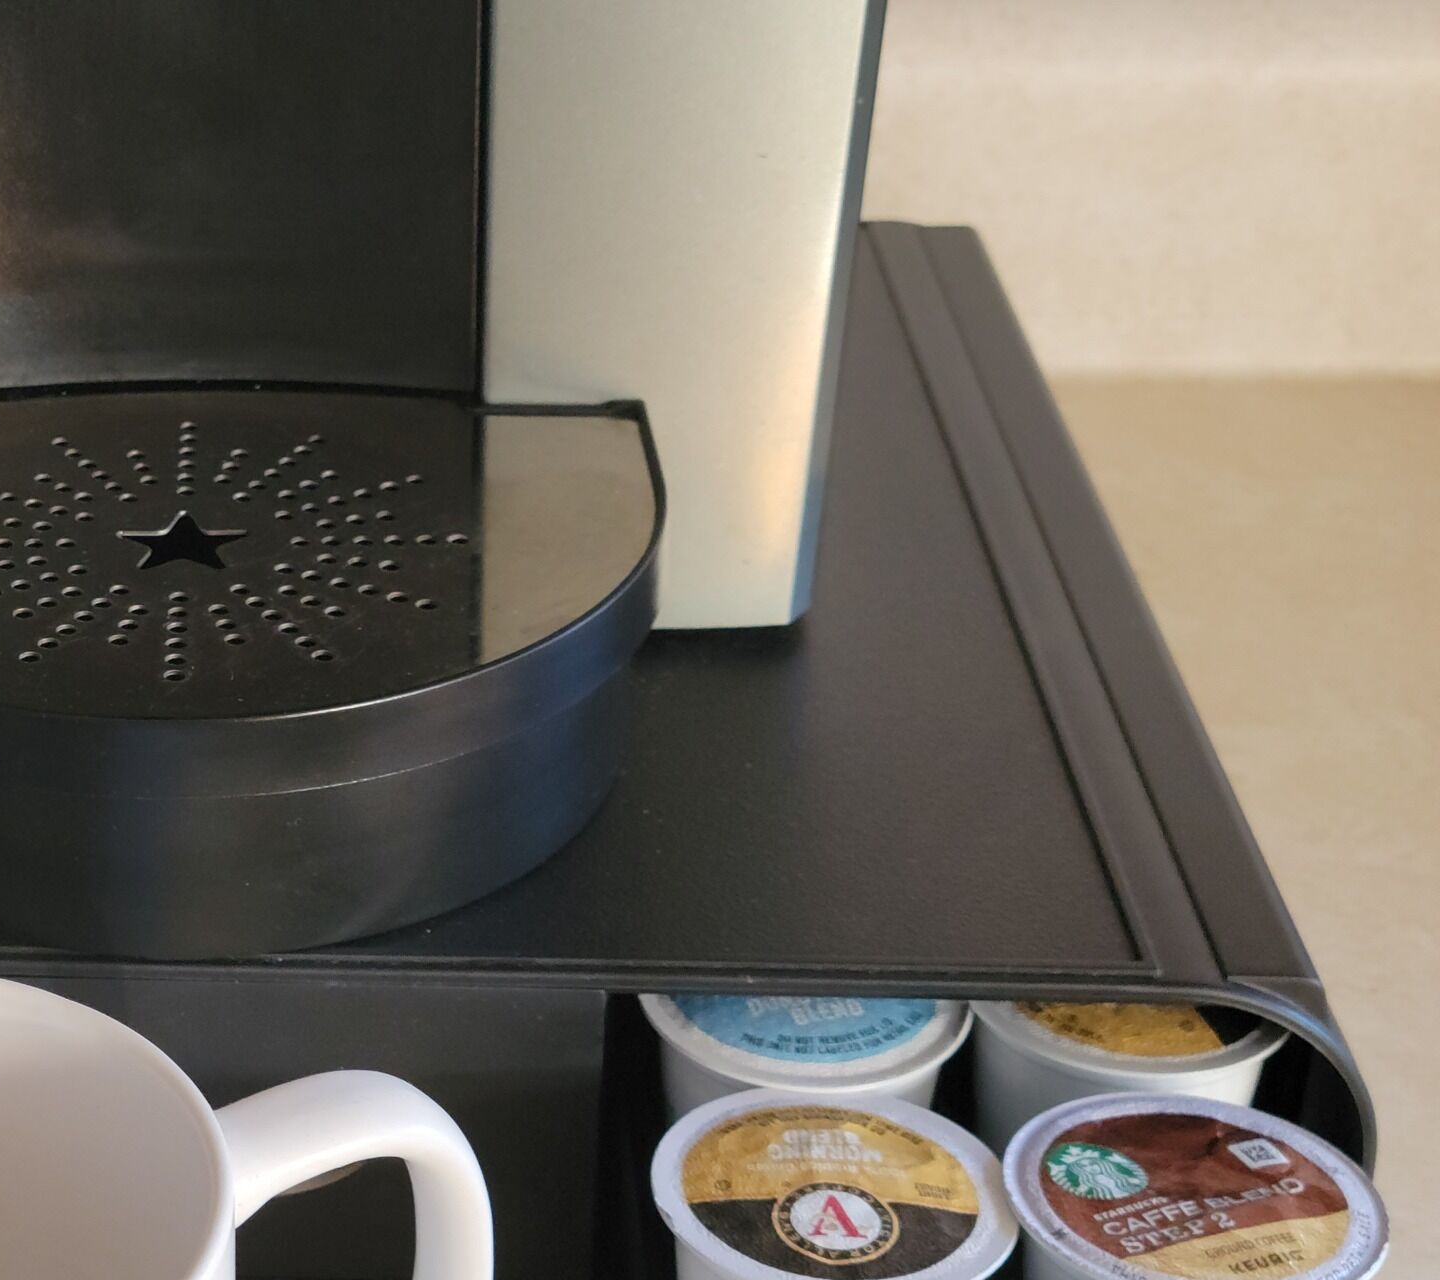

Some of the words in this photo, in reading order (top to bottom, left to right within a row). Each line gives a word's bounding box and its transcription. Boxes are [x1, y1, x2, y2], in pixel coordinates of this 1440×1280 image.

[1204, 1177, 1305, 1209] BLEND
[1120, 1219, 1205, 1254] STEP
[1210, 1211, 1236, 1229] 2
[1228, 1250, 1305, 1274] KEURIG
